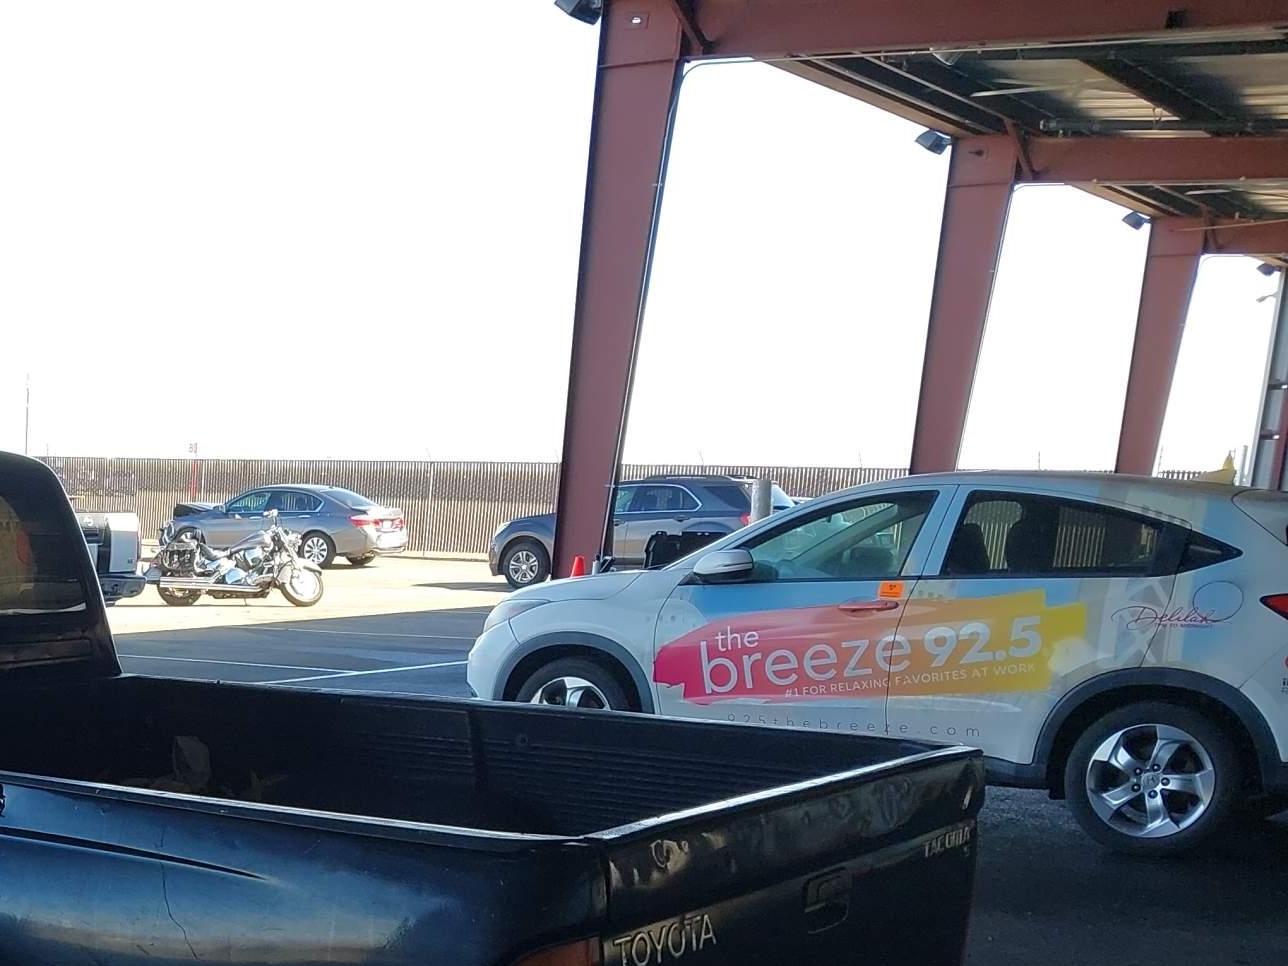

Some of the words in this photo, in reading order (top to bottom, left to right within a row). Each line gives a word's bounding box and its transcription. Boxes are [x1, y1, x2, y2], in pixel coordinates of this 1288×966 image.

[700, 632, 912, 695] breeze
[923, 615, 1042, 668] 92.5
[715, 626, 759, 652] the
[785, 687, 799, 699] #1
[801, 683, 827, 696] FOR
[830, 676, 891, 693] RELAXING
[895, 668, 968, 687] FAVORITES
[972, 666, 988, 679] AT
[993, 663, 1037, 676] WORK
